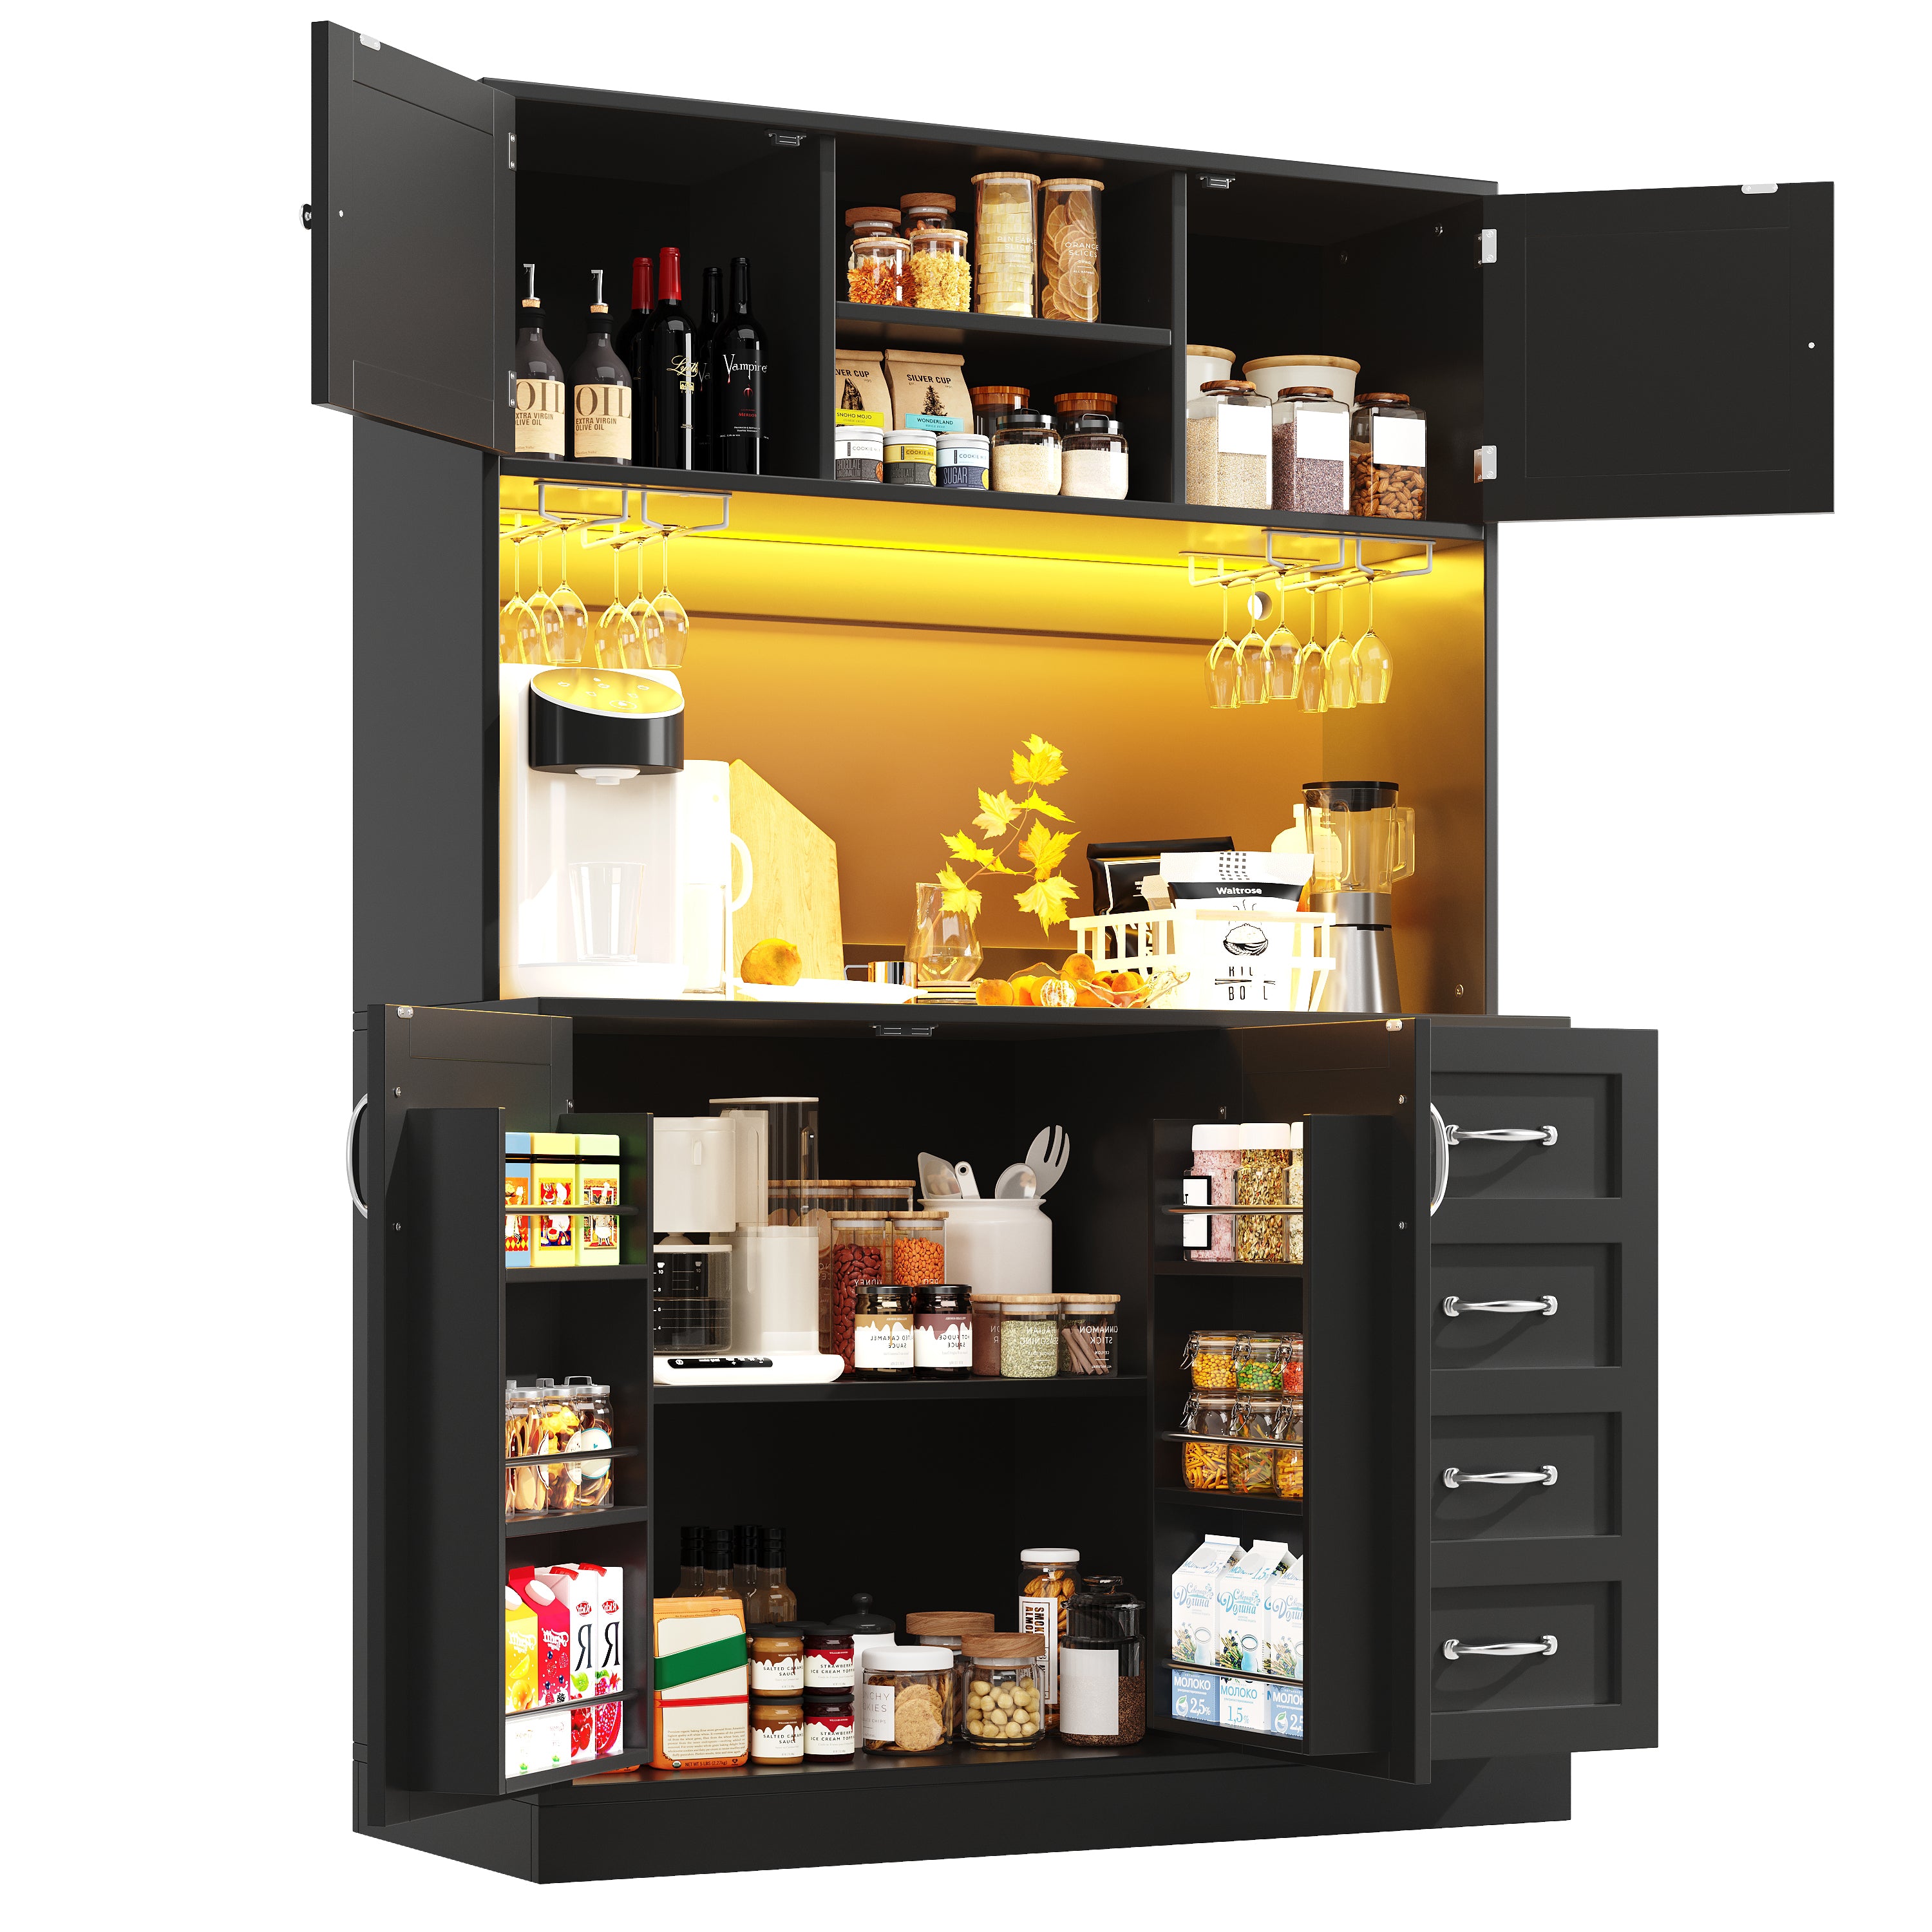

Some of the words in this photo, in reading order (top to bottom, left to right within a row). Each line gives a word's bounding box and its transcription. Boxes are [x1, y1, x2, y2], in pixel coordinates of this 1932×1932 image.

[723, 354, 767, 380] Vampire
[853, 370, 869, 378] CUP
[906, 374, 934, 383] SILVER
[516, 381, 565, 414] OIL
[576, 386, 631, 419] OIL
[837, 459, 861, 470] CHOCOLATE
[943, 467, 967, 484] SUGAR
[1215, 887, 1262, 895] Waitrose
[1228, 985, 1268, 1001] BOL
[1173, 1585, 1209, 1609] Долина
[1220, 1591, 1256, 1616] Долина
[1174, 1676, 1211, 1691] МОЛОКО
[1220, 1685, 1258, 1700] МОЛОКО
[863, 1702, 887, 1712] OKIES
[1189, 1698, 1211, 1716] 2,5%
[1227, 1705, 1249, 1724] 1,5%
[1289, 1714, 1303, 1734] 2,5
